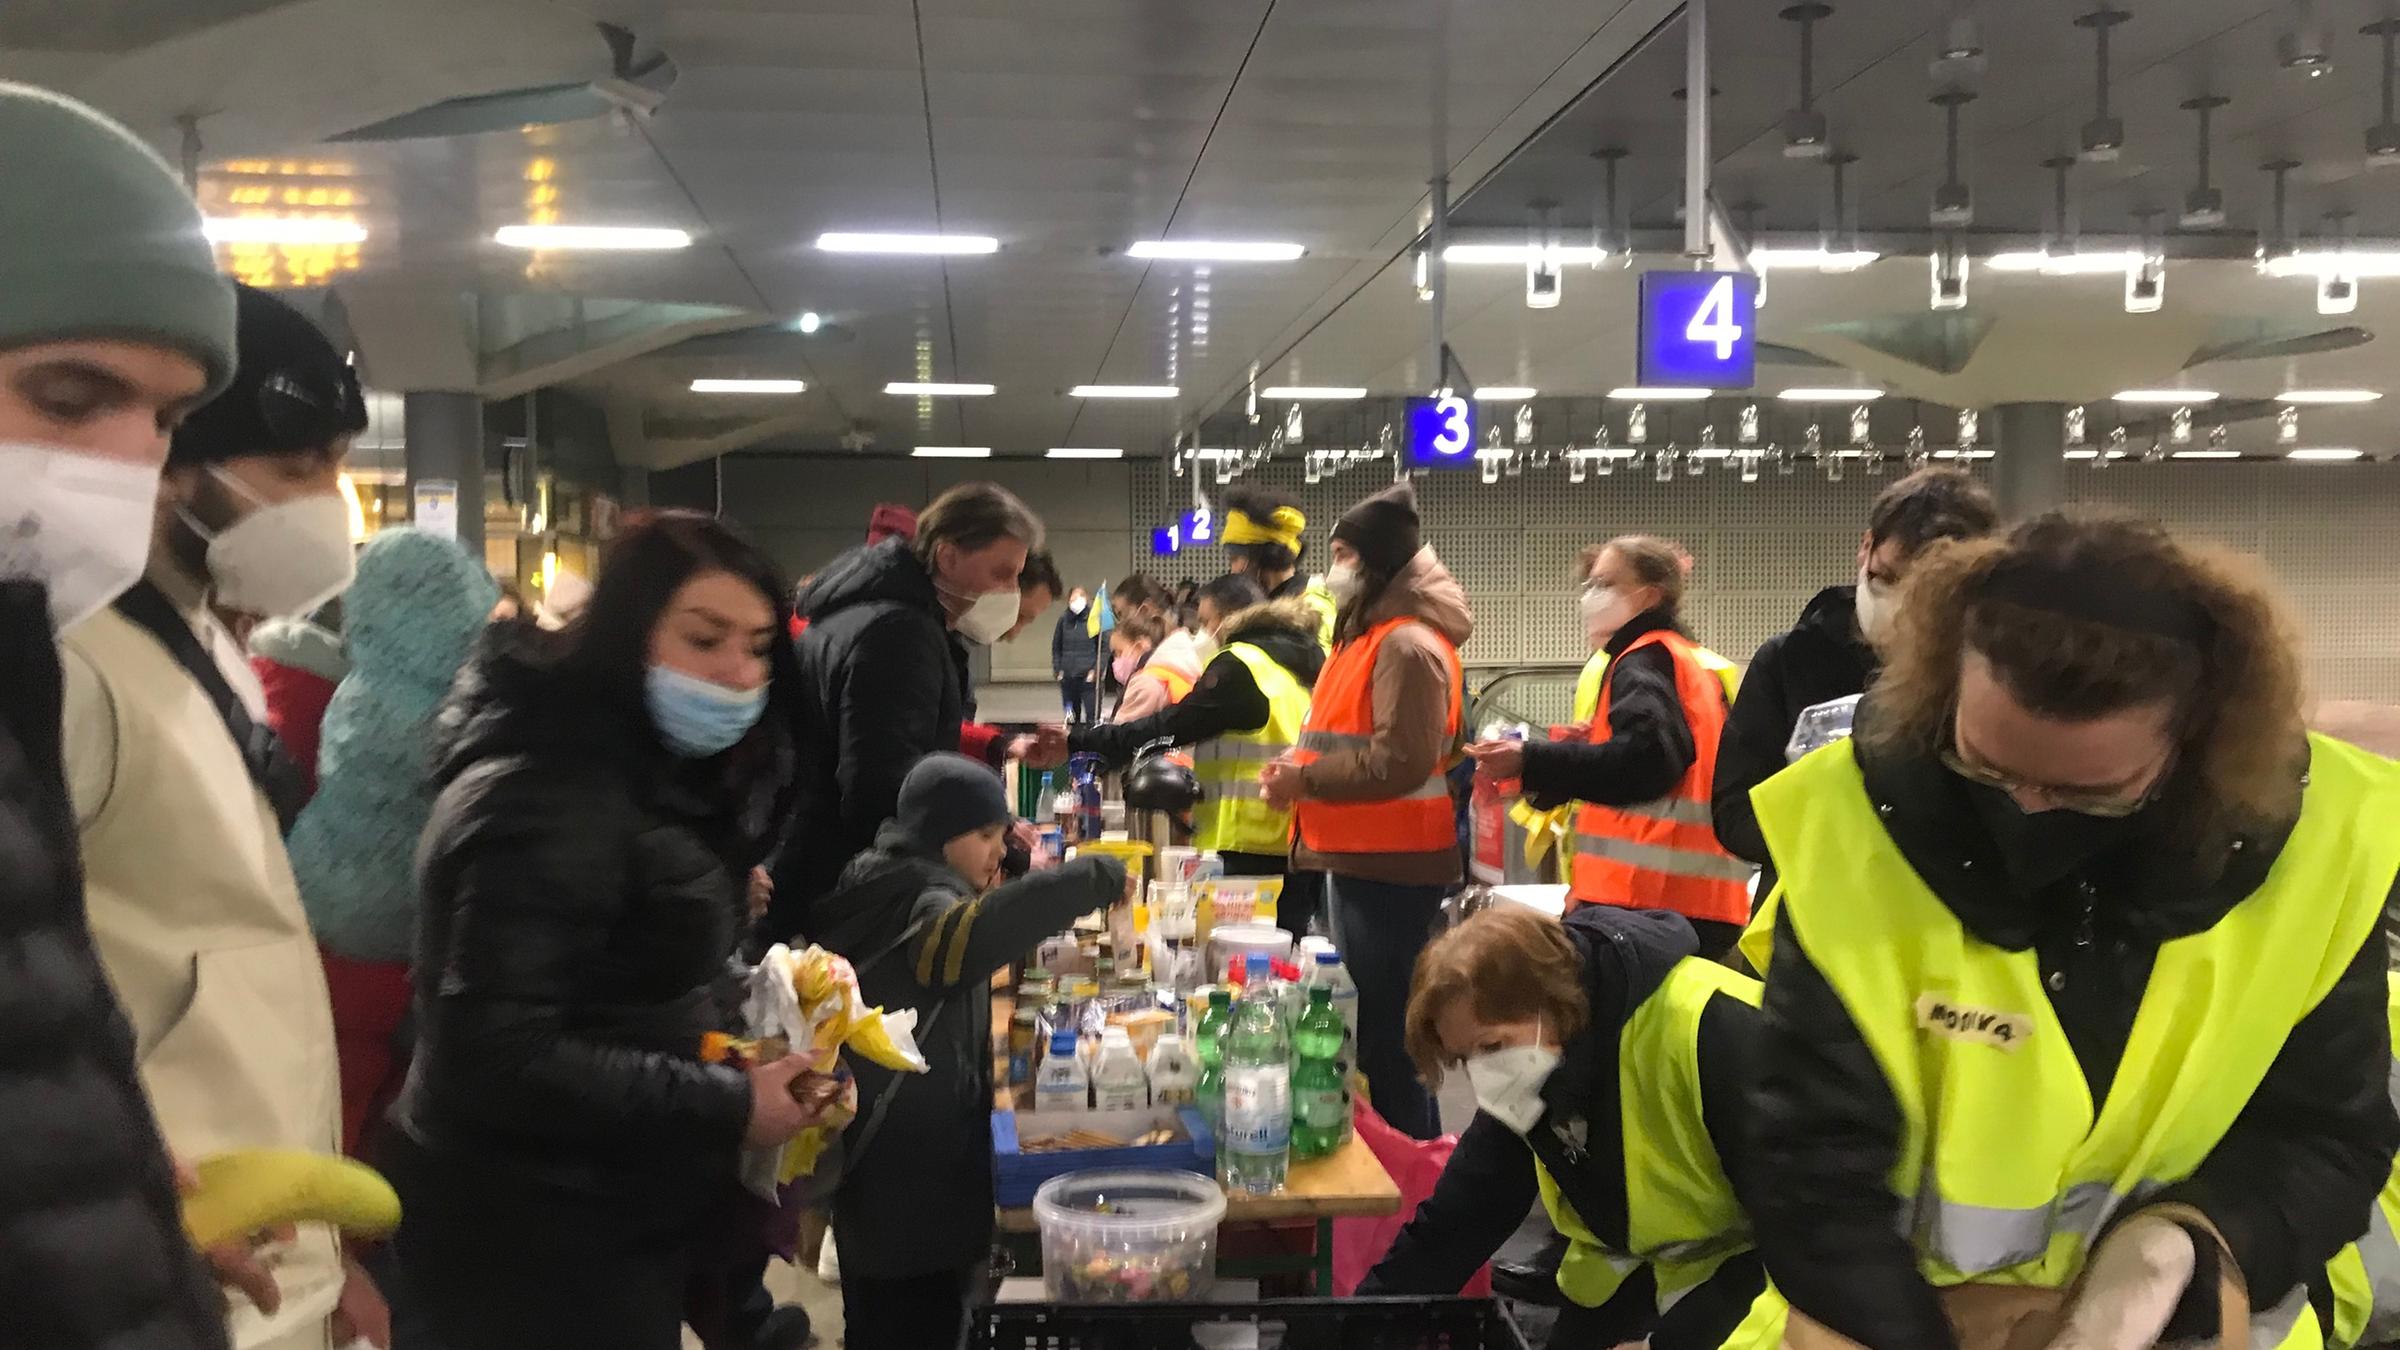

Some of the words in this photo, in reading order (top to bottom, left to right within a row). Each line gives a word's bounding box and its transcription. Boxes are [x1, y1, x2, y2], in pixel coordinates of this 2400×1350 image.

[1686, 275, 1742, 360] 4
[1433, 396, 1470, 455] 3
[1167, 524, 1179, 552] 1
[1192, 508, 1211, 540] 2
